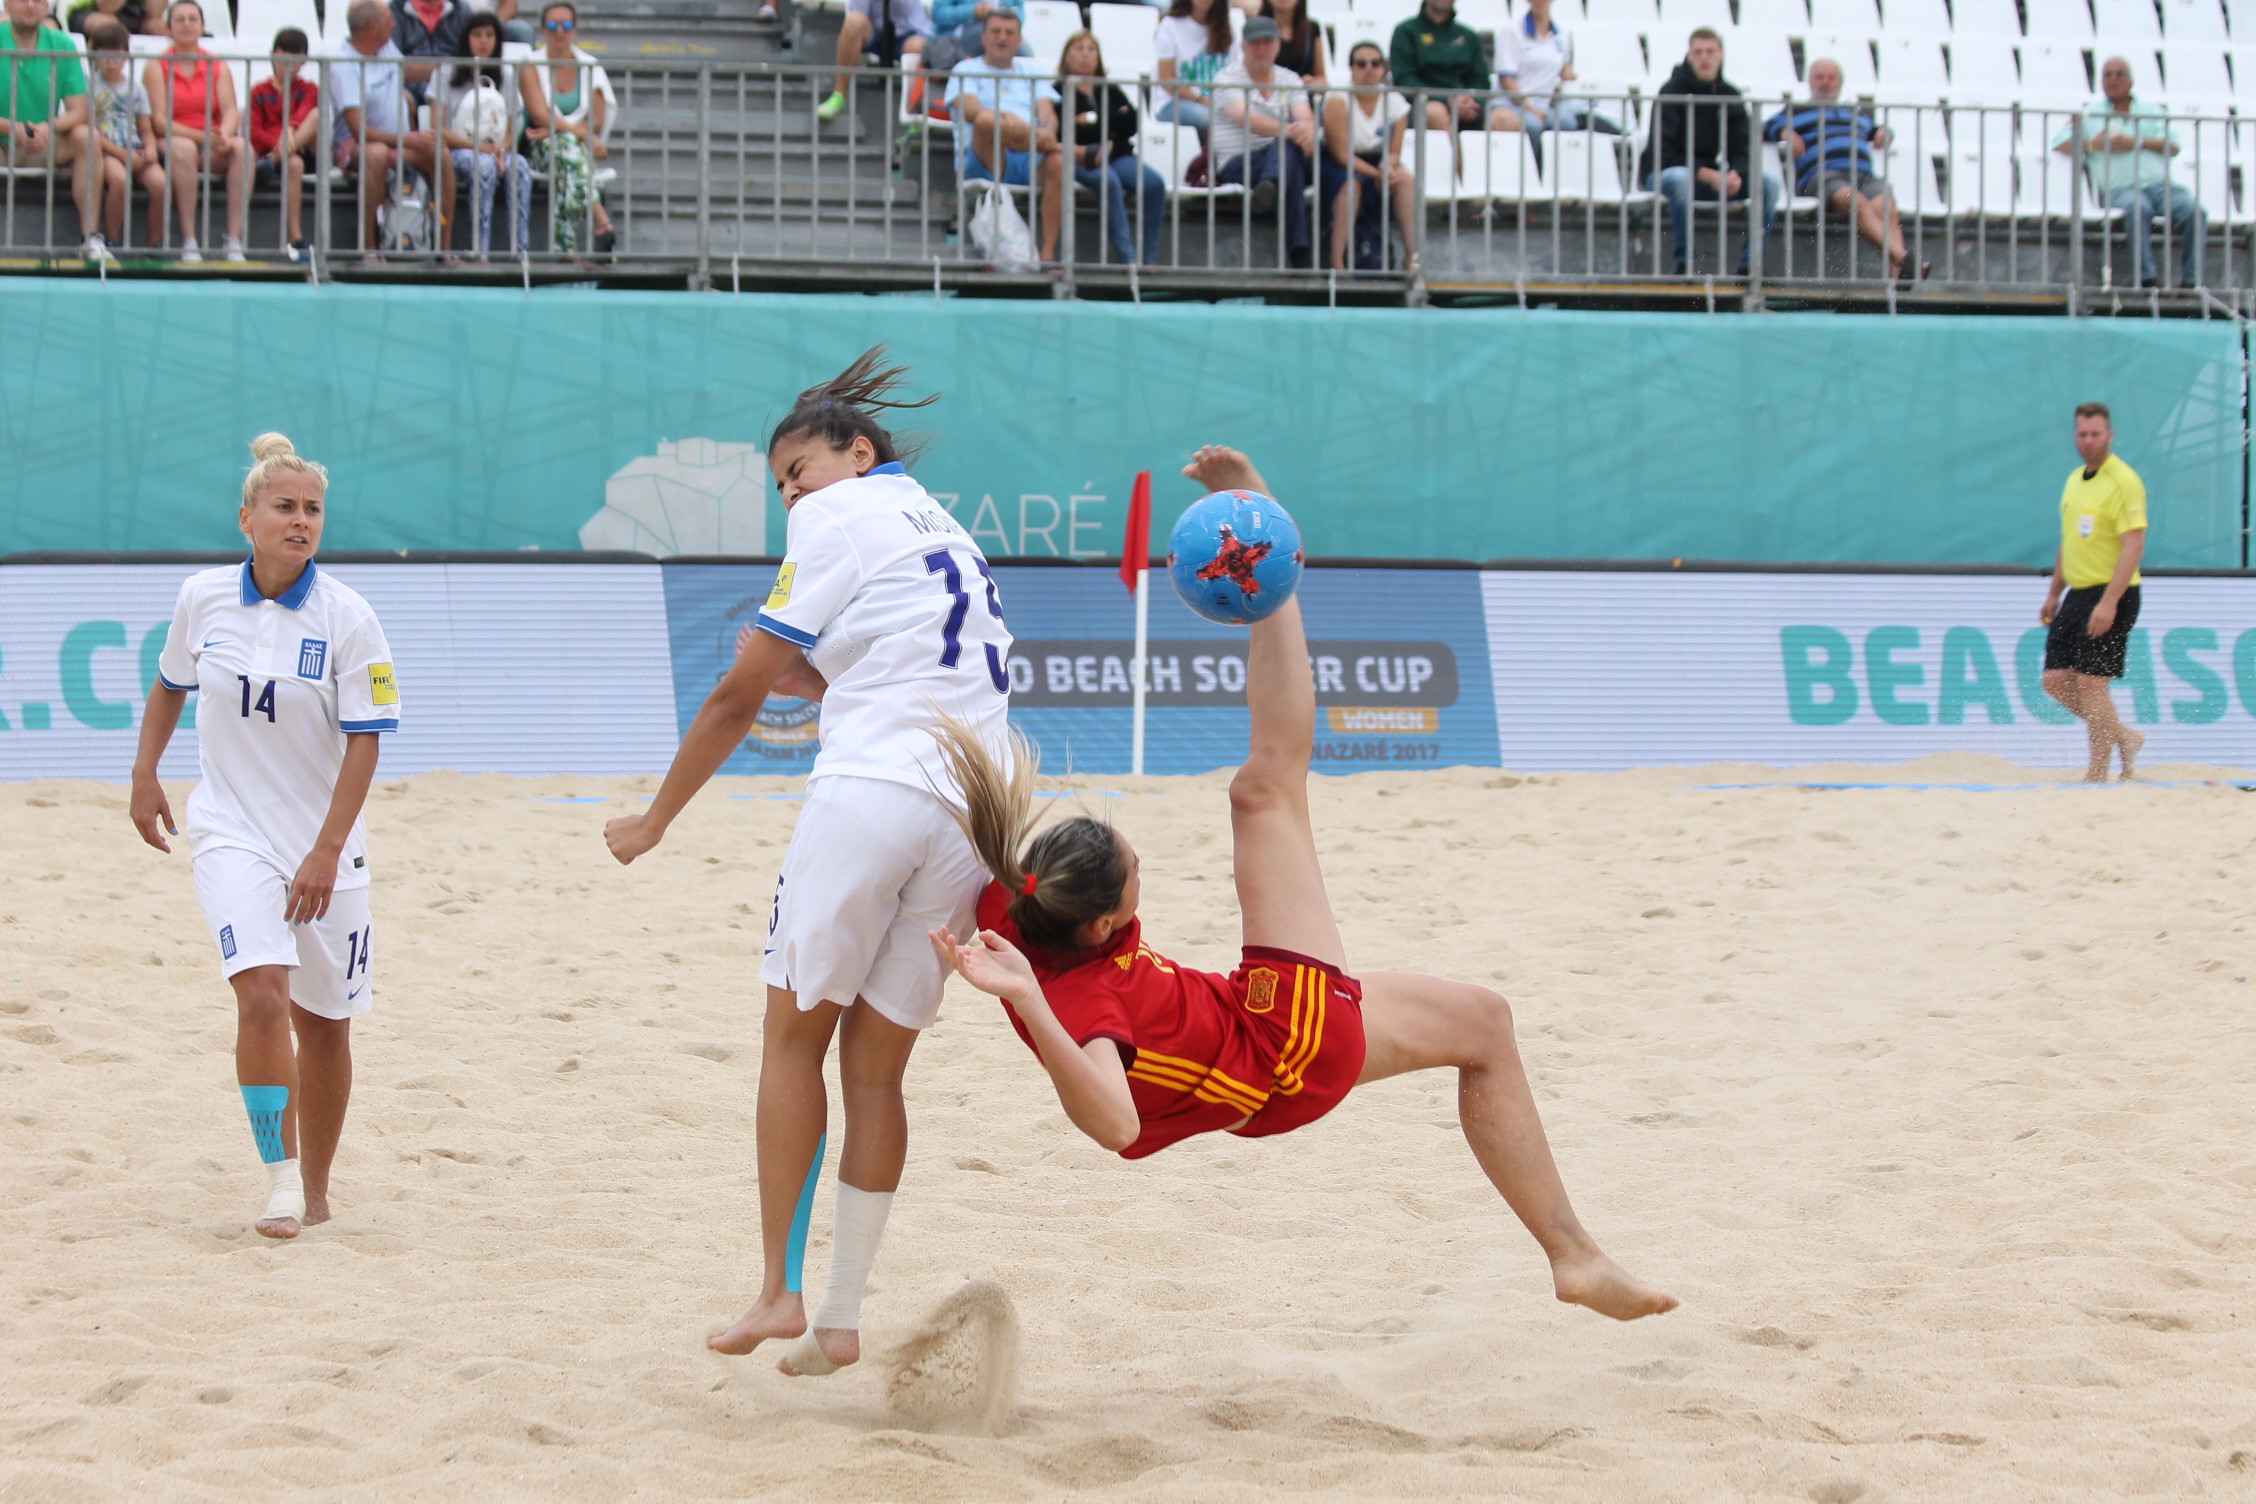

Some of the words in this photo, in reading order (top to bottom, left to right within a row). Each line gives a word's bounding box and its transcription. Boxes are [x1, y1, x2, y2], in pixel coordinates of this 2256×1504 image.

[922, 548, 1011, 695] 15
[1046, 655, 1182, 693] BEACH
[1356, 655, 1434, 693] CUP
[238, 675, 276, 723] 14
[1342, 710, 1425, 730] WOMEN
[1393, 743, 1440, 761] 2017
[346, 923, 370, 980] 14
